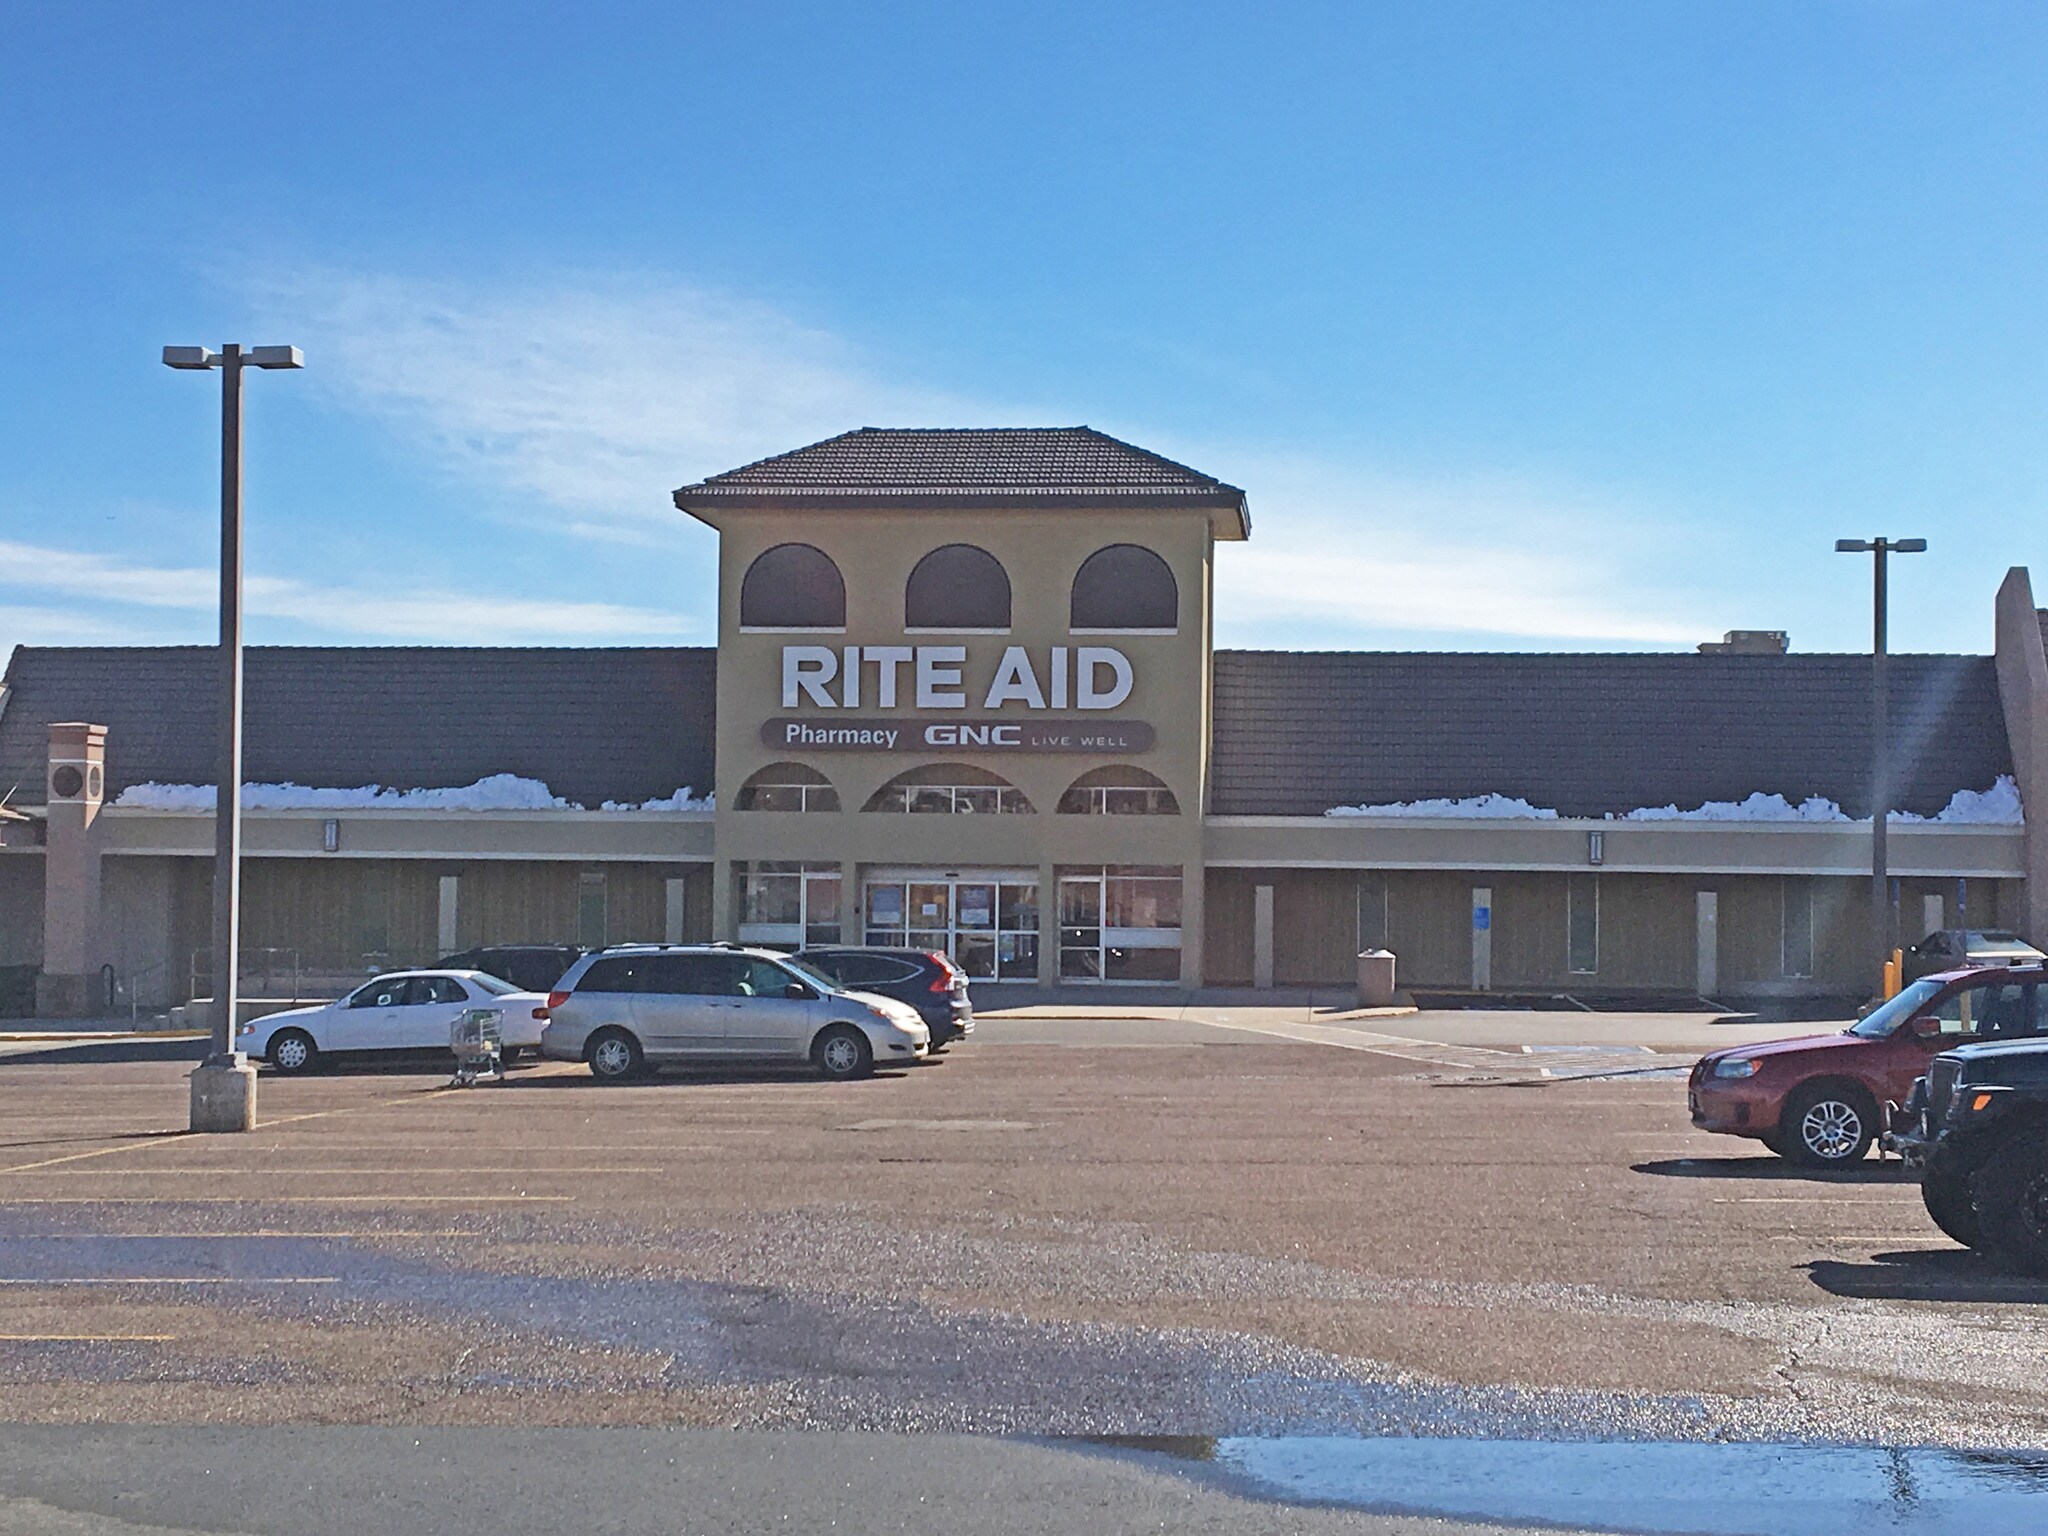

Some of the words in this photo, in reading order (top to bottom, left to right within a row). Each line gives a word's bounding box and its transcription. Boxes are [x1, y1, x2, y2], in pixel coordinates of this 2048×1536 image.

[782, 646, 966, 708] RITE
[984, 646, 1134, 709] AID
[785, 724, 898, 749] Pharmacy
[924, 725, 1022, 746] GNC
[1031, 736, 1071, 747] LIVE
[1081, 736, 1128, 747] WELL
